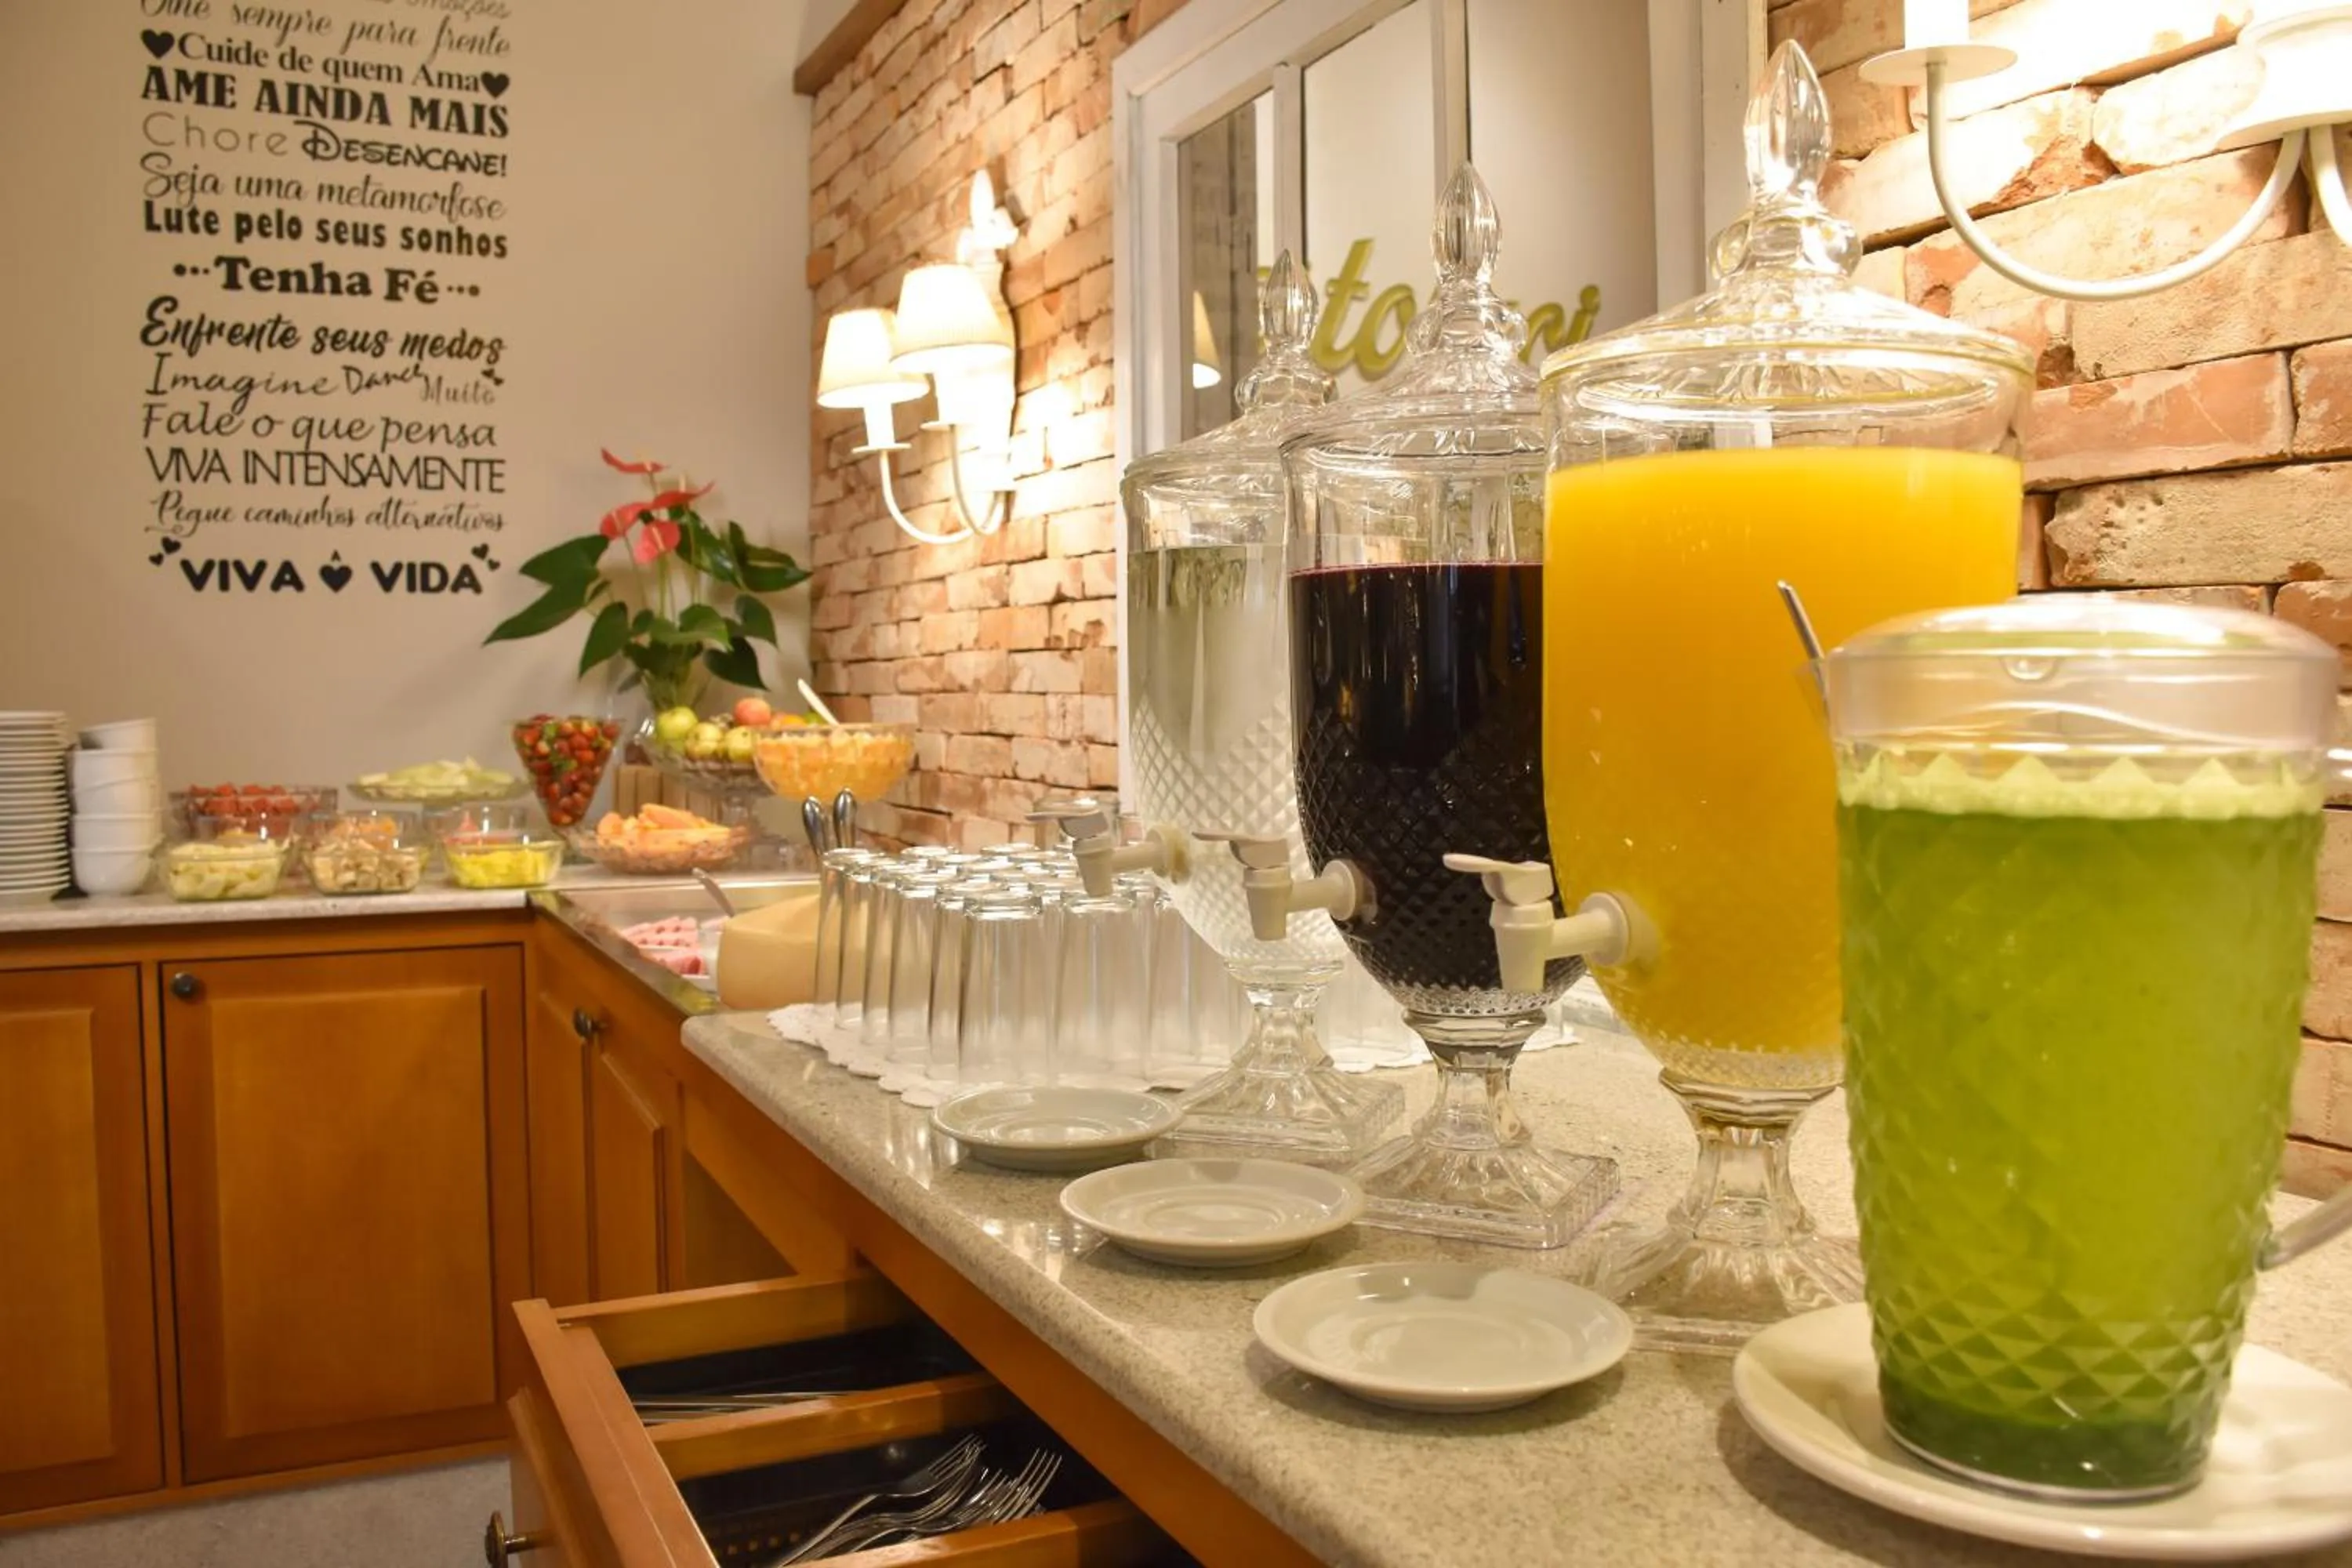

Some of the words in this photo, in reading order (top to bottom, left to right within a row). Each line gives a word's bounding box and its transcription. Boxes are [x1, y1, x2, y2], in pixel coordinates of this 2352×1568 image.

[178, 31, 269, 69] Cuide
[278, 45, 314, 74] de
[322, 55, 402, 84] quem
[412, 63, 481, 93] Ama
[339, 20, 420, 56] para
[429, 13, 511, 64] frente
[141, 65, 238, 109] AME
[254, 78, 391, 126] AINDA
[408, 95, 510, 140] MAIS
[142, 111, 289, 157] Chore
[140, 151, 220, 209] Seja
[235, 174, 306, 201] uma
[316, 173, 509, 224] metamorfose
[144, 199, 221, 235] Lute
[234, 208, 304, 244] pelo
[315, 217, 388, 249] seus
[399, 224, 510, 260] sonhos
[214, 255, 372, 297] Tenha
[383, 267, 441, 305] Fé
[140, 295, 303, 358] Enfrente
[310, 324, 394, 356] seus
[399, 328, 508, 366] medos
[145, 351, 340, 417] Imagine
[142, 401, 245, 439] Fale
[252, 414, 285, 440] o
[291, 414, 375, 452] que
[381, 415, 498, 455] pensa
[145, 445, 232, 485] VIVA
[243, 449, 506, 494] INTENSAMENTE
[143, 489, 236, 539] Pegue
[242, 494, 357, 530] caminhos
[364, 495, 509, 533] alternativos
[180, 558, 306, 593] VIVA
[370, 561, 483, 595] VIDA
